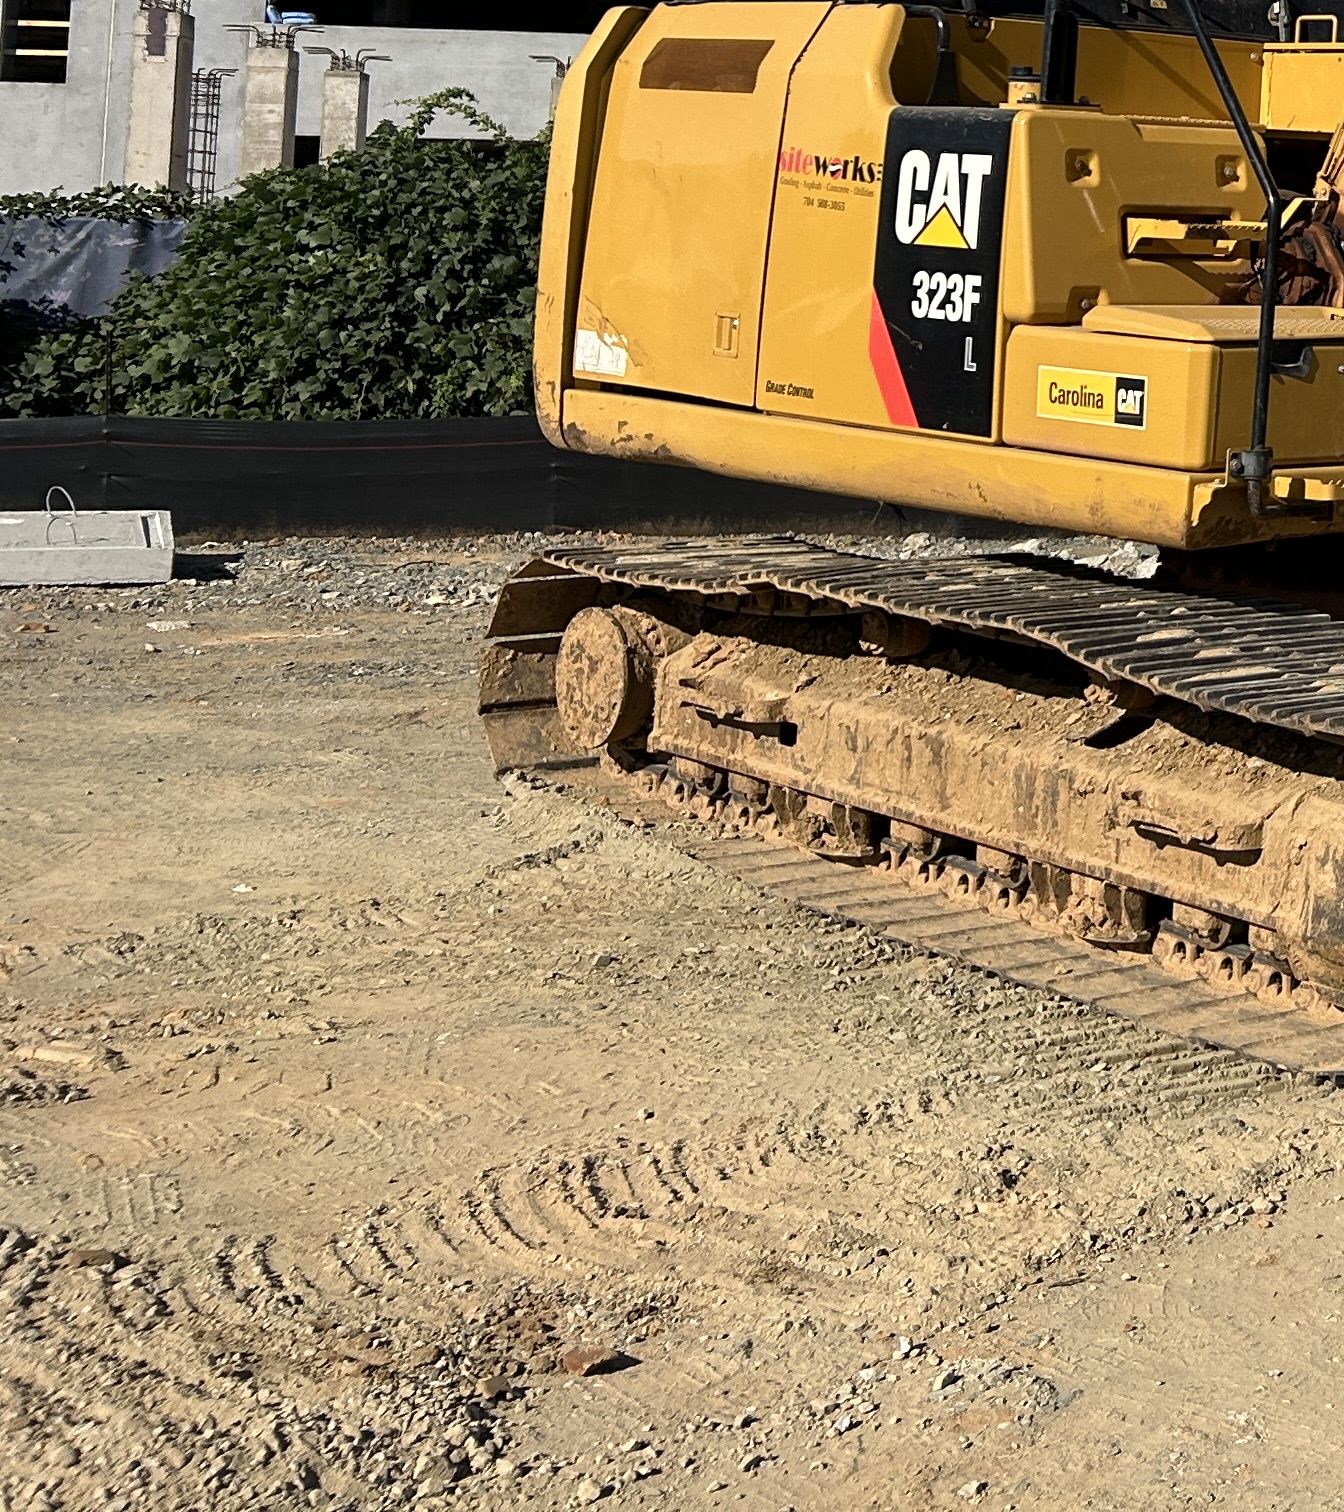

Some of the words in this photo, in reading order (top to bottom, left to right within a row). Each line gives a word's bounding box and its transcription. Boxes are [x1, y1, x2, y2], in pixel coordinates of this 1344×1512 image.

[895, 149, 993, 250] CAT
[911, 270, 982, 323] 323F
[963, 336, 977, 372] L
[1048, 381, 1104, 409] Carolina
[1117, 388, 1144, 415] CAT
